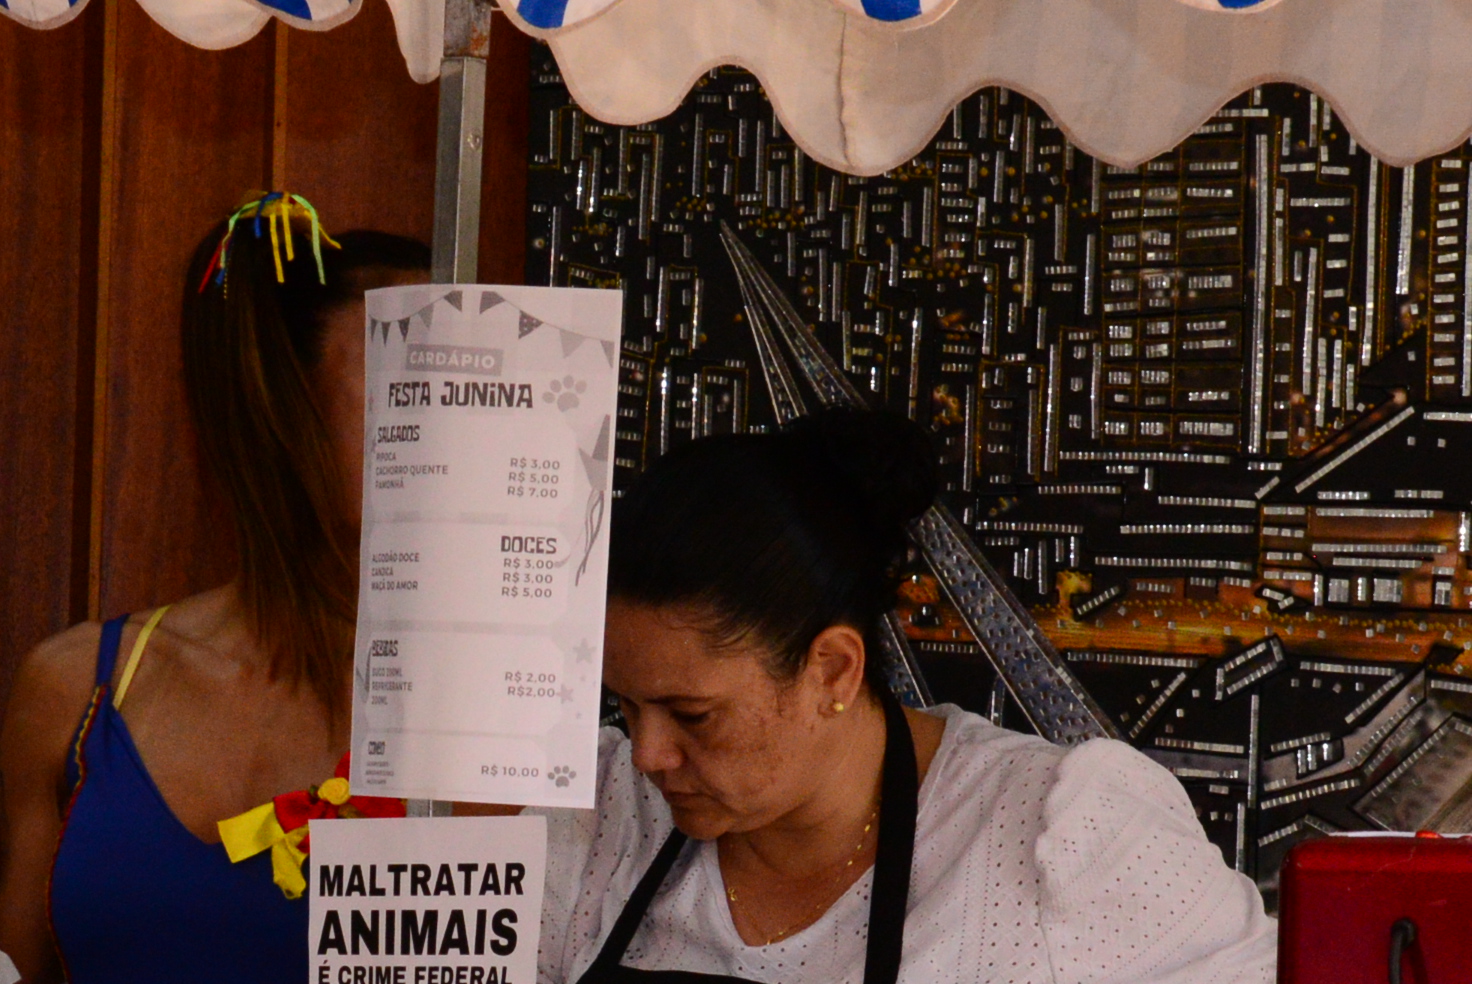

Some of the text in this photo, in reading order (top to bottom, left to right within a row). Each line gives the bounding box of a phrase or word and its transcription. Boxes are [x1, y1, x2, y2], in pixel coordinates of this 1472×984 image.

[409, 350, 495, 369] CARDÁPIO
[388, 381, 431, 408] FESTA
[377, 425, 420, 444] SALGADOS
[510, 457, 527, 469] R$
[409, 464, 448, 476] QUENTE
[508, 471, 525, 483] R$
[507, 485, 524, 498] R$
[501, 535, 557, 554] DOCES
[503, 557, 520, 569] R$
[503, 571, 520, 583] R$
[396, 580, 418, 590] AMOR
[501, 585, 518, 598] R$
[504, 670, 522, 683] R$
[481, 764, 498, 778] R$
[319, 862, 525, 897] MALTRATAR
[317, 908, 518, 956] ANIMAIS
